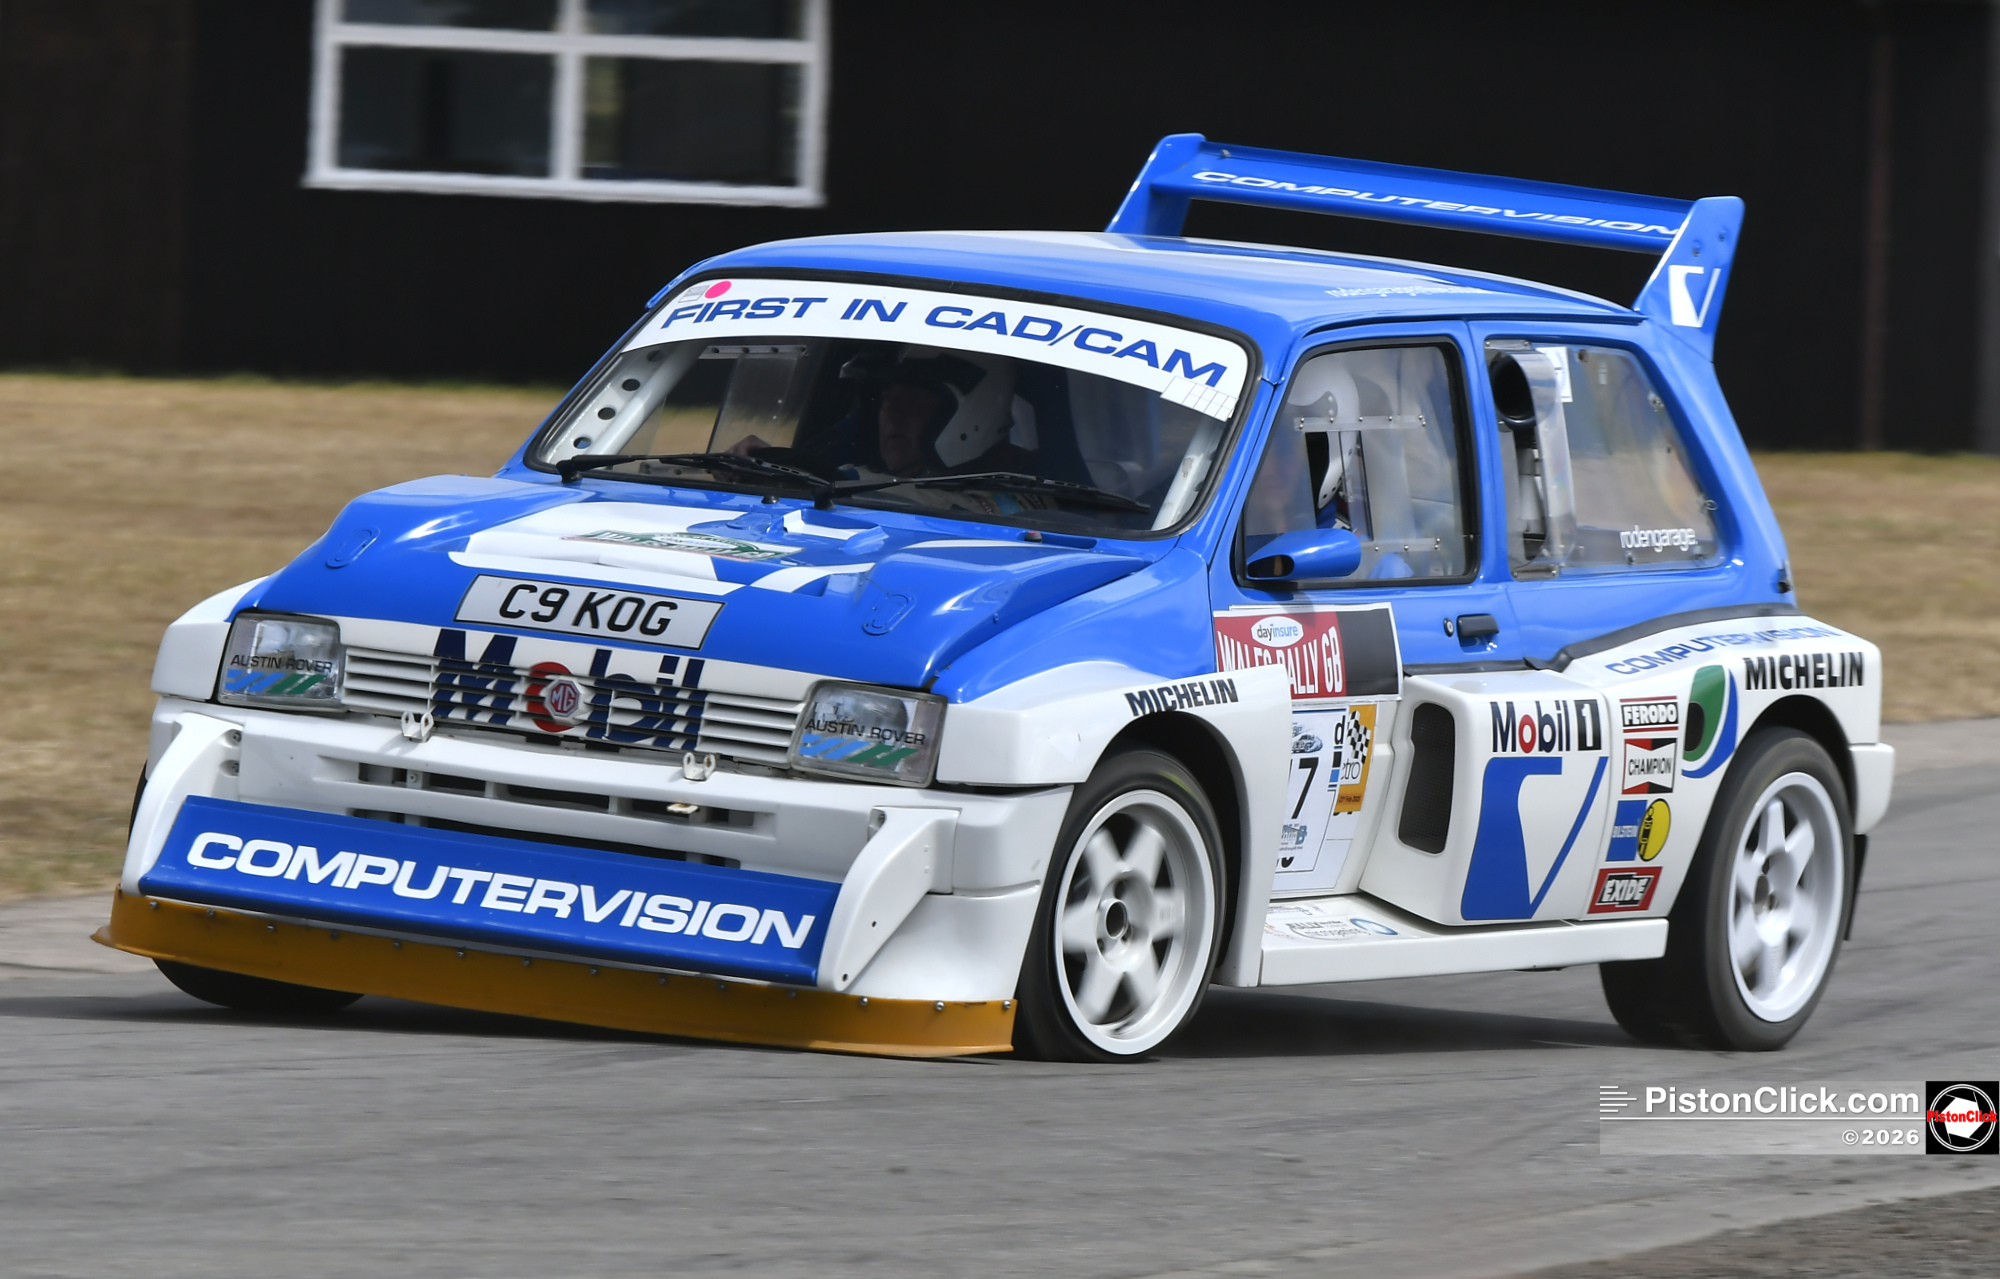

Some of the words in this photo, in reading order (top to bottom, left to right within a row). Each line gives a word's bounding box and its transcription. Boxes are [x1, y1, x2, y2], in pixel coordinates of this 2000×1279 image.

[1192, 171, 1680, 235] COMPUTERVISION
[661, 297, 826, 329] FIRST
[842, 298, 907, 322] IN
[925, 305, 1228, 388] CAD/CAM
[499, 584, 570, 623] C9
[572, 591, 678, 636] KOG
[1257, 623, 1299, 641] dayinsure
[1604, 626, 1843, 675] COMPUTERVISION
[230, 654, 282, 669] AUSTIN
[286, 657, 333, 673] ROVER
[1321, 626, 1343, 693] GB
[1742, 652, 1865, 690] MICHELIN
[1124, 678, 1239, 717] MICHELIN
[1623, 703, 1678, 726] FERODO
[805, 718, 866, 737] AUSTIN
[871, 726, 926, 745] ROVER
[1489, 700, 1571, 754] Mobil
[1628, 757, 1673, 776] CHAMPION
[186, 832, 815, 949] COMPUTERVISION
[1601, 878, 1649, 902] EXIDE
